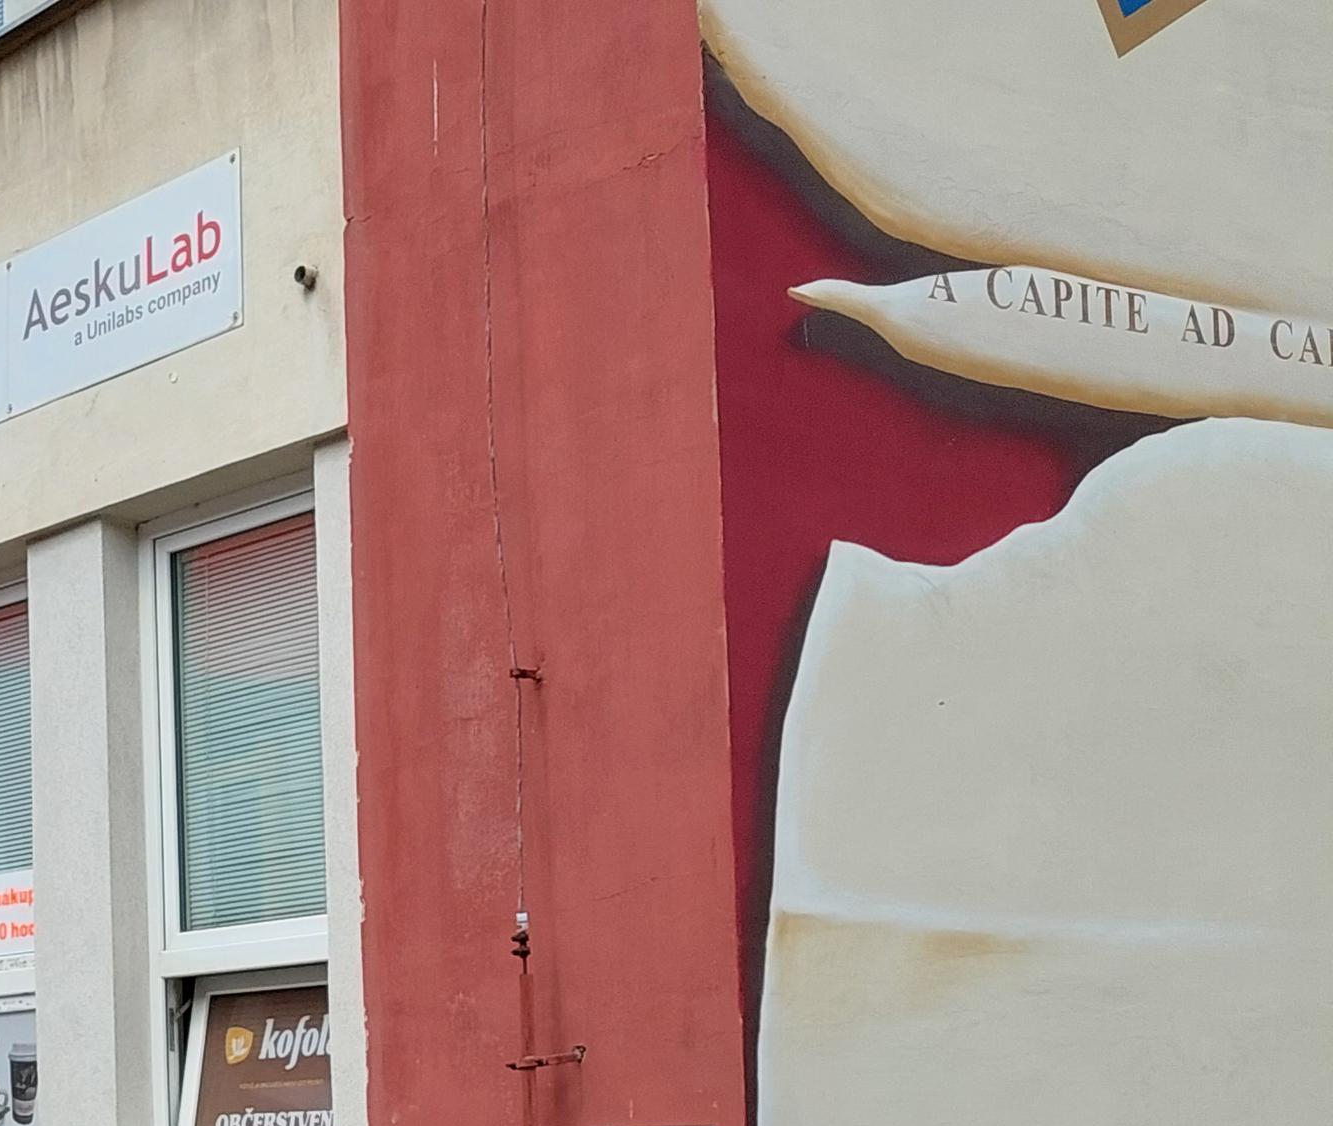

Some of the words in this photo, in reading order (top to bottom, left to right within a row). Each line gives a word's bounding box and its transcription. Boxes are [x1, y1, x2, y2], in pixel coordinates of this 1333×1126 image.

[23, 211, 222, 340] AeskuLab
[74, 328, 83, 347] a
[85, 301, 143, 342] Unilabs
[147, 270, 222, 317] company
[929, 272, 957, 303] A
[987, 267, 1150, 335] CAPITE
[1180, 303, 1236, 348] AD
[258, 1014, 331, 1071] kofol
